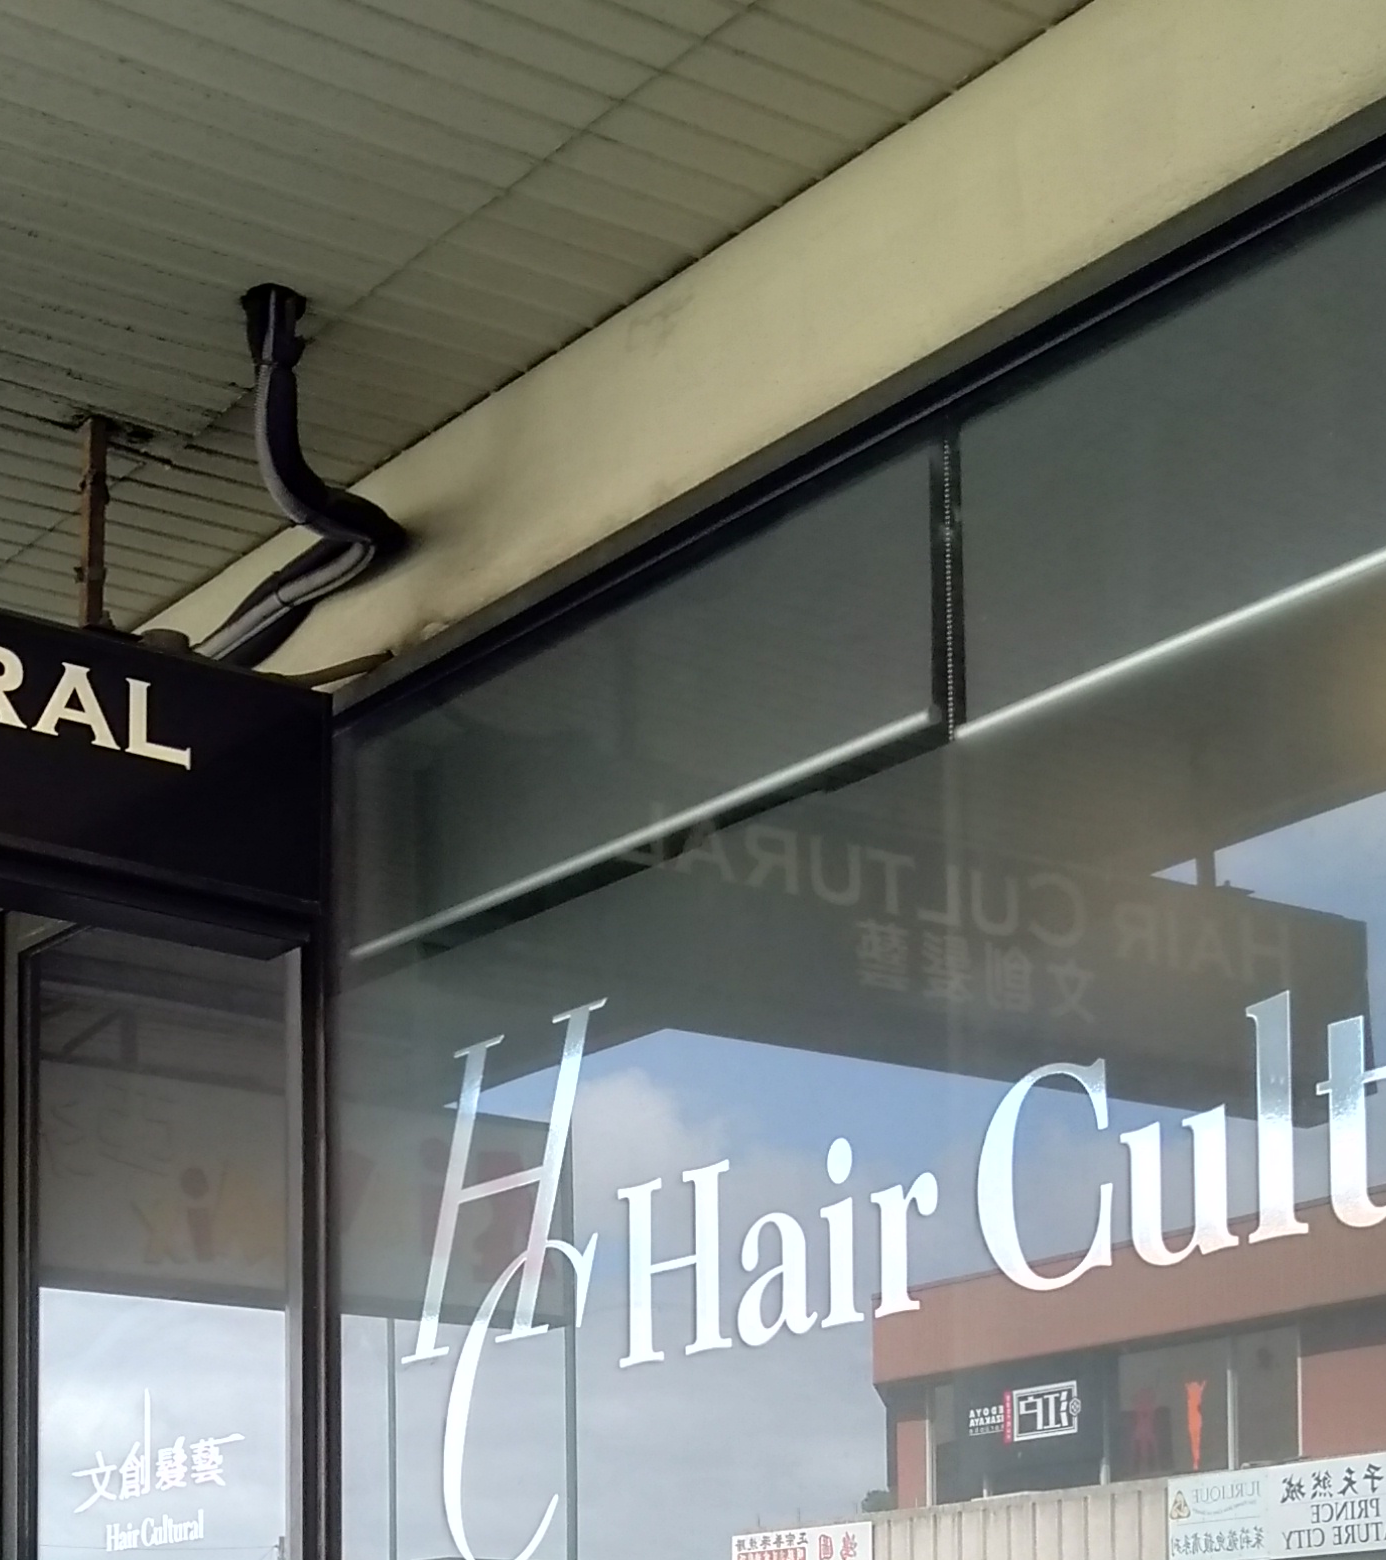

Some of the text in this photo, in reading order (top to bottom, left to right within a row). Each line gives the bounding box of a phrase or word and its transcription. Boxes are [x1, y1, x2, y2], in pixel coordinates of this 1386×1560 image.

[619, 1138, 939, 1368] Hair
[72, 1388, 245, 1513] 文創髮藝
[106, 1509, 204, 1551] Hair Cultural
